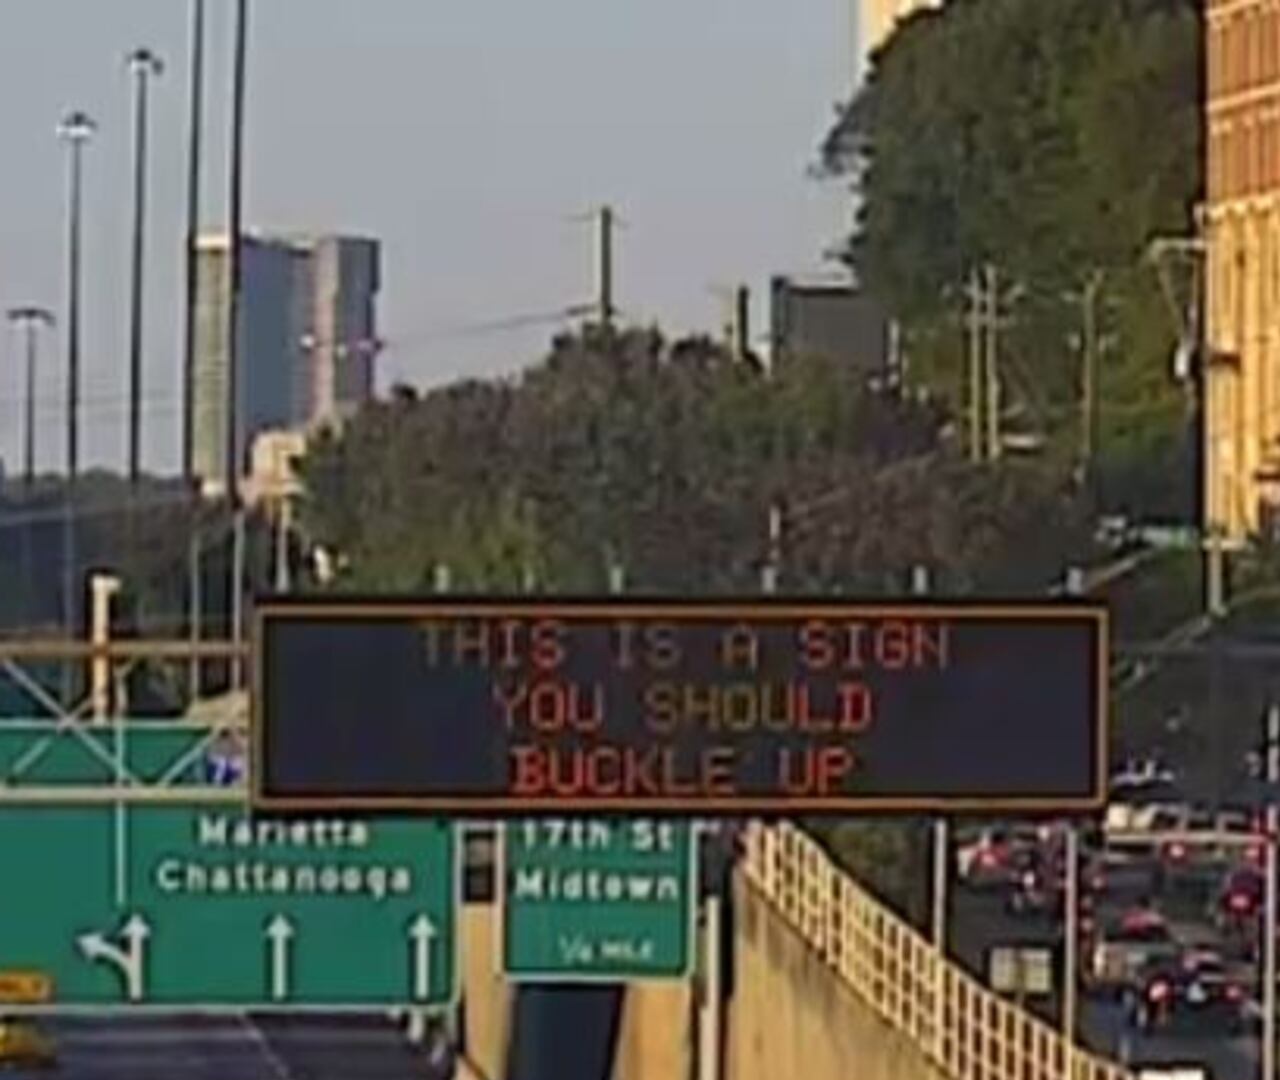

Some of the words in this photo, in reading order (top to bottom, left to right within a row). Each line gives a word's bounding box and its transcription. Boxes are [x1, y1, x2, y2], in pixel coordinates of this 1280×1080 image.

[420, 620, 567, 668] THIS
[614, 623, 681, 668] IS
[721, 624, 758, 669] A
[801, 620, 950, 669] SIGN
[491, 683, 604, 730] YOU
[645, 683, 872, 731] SHOULD
[510, 745, 736, 793] BUCKLE
[778, 746, 853, 795] UP
[197, 814, 370, 846] Marietta
[522, 819, 609, 848] 17th
[632, 819, 674, 850] St
[156, 859, 412, 899] Chattanooga
[514, 868, 680, 899] Midtown
